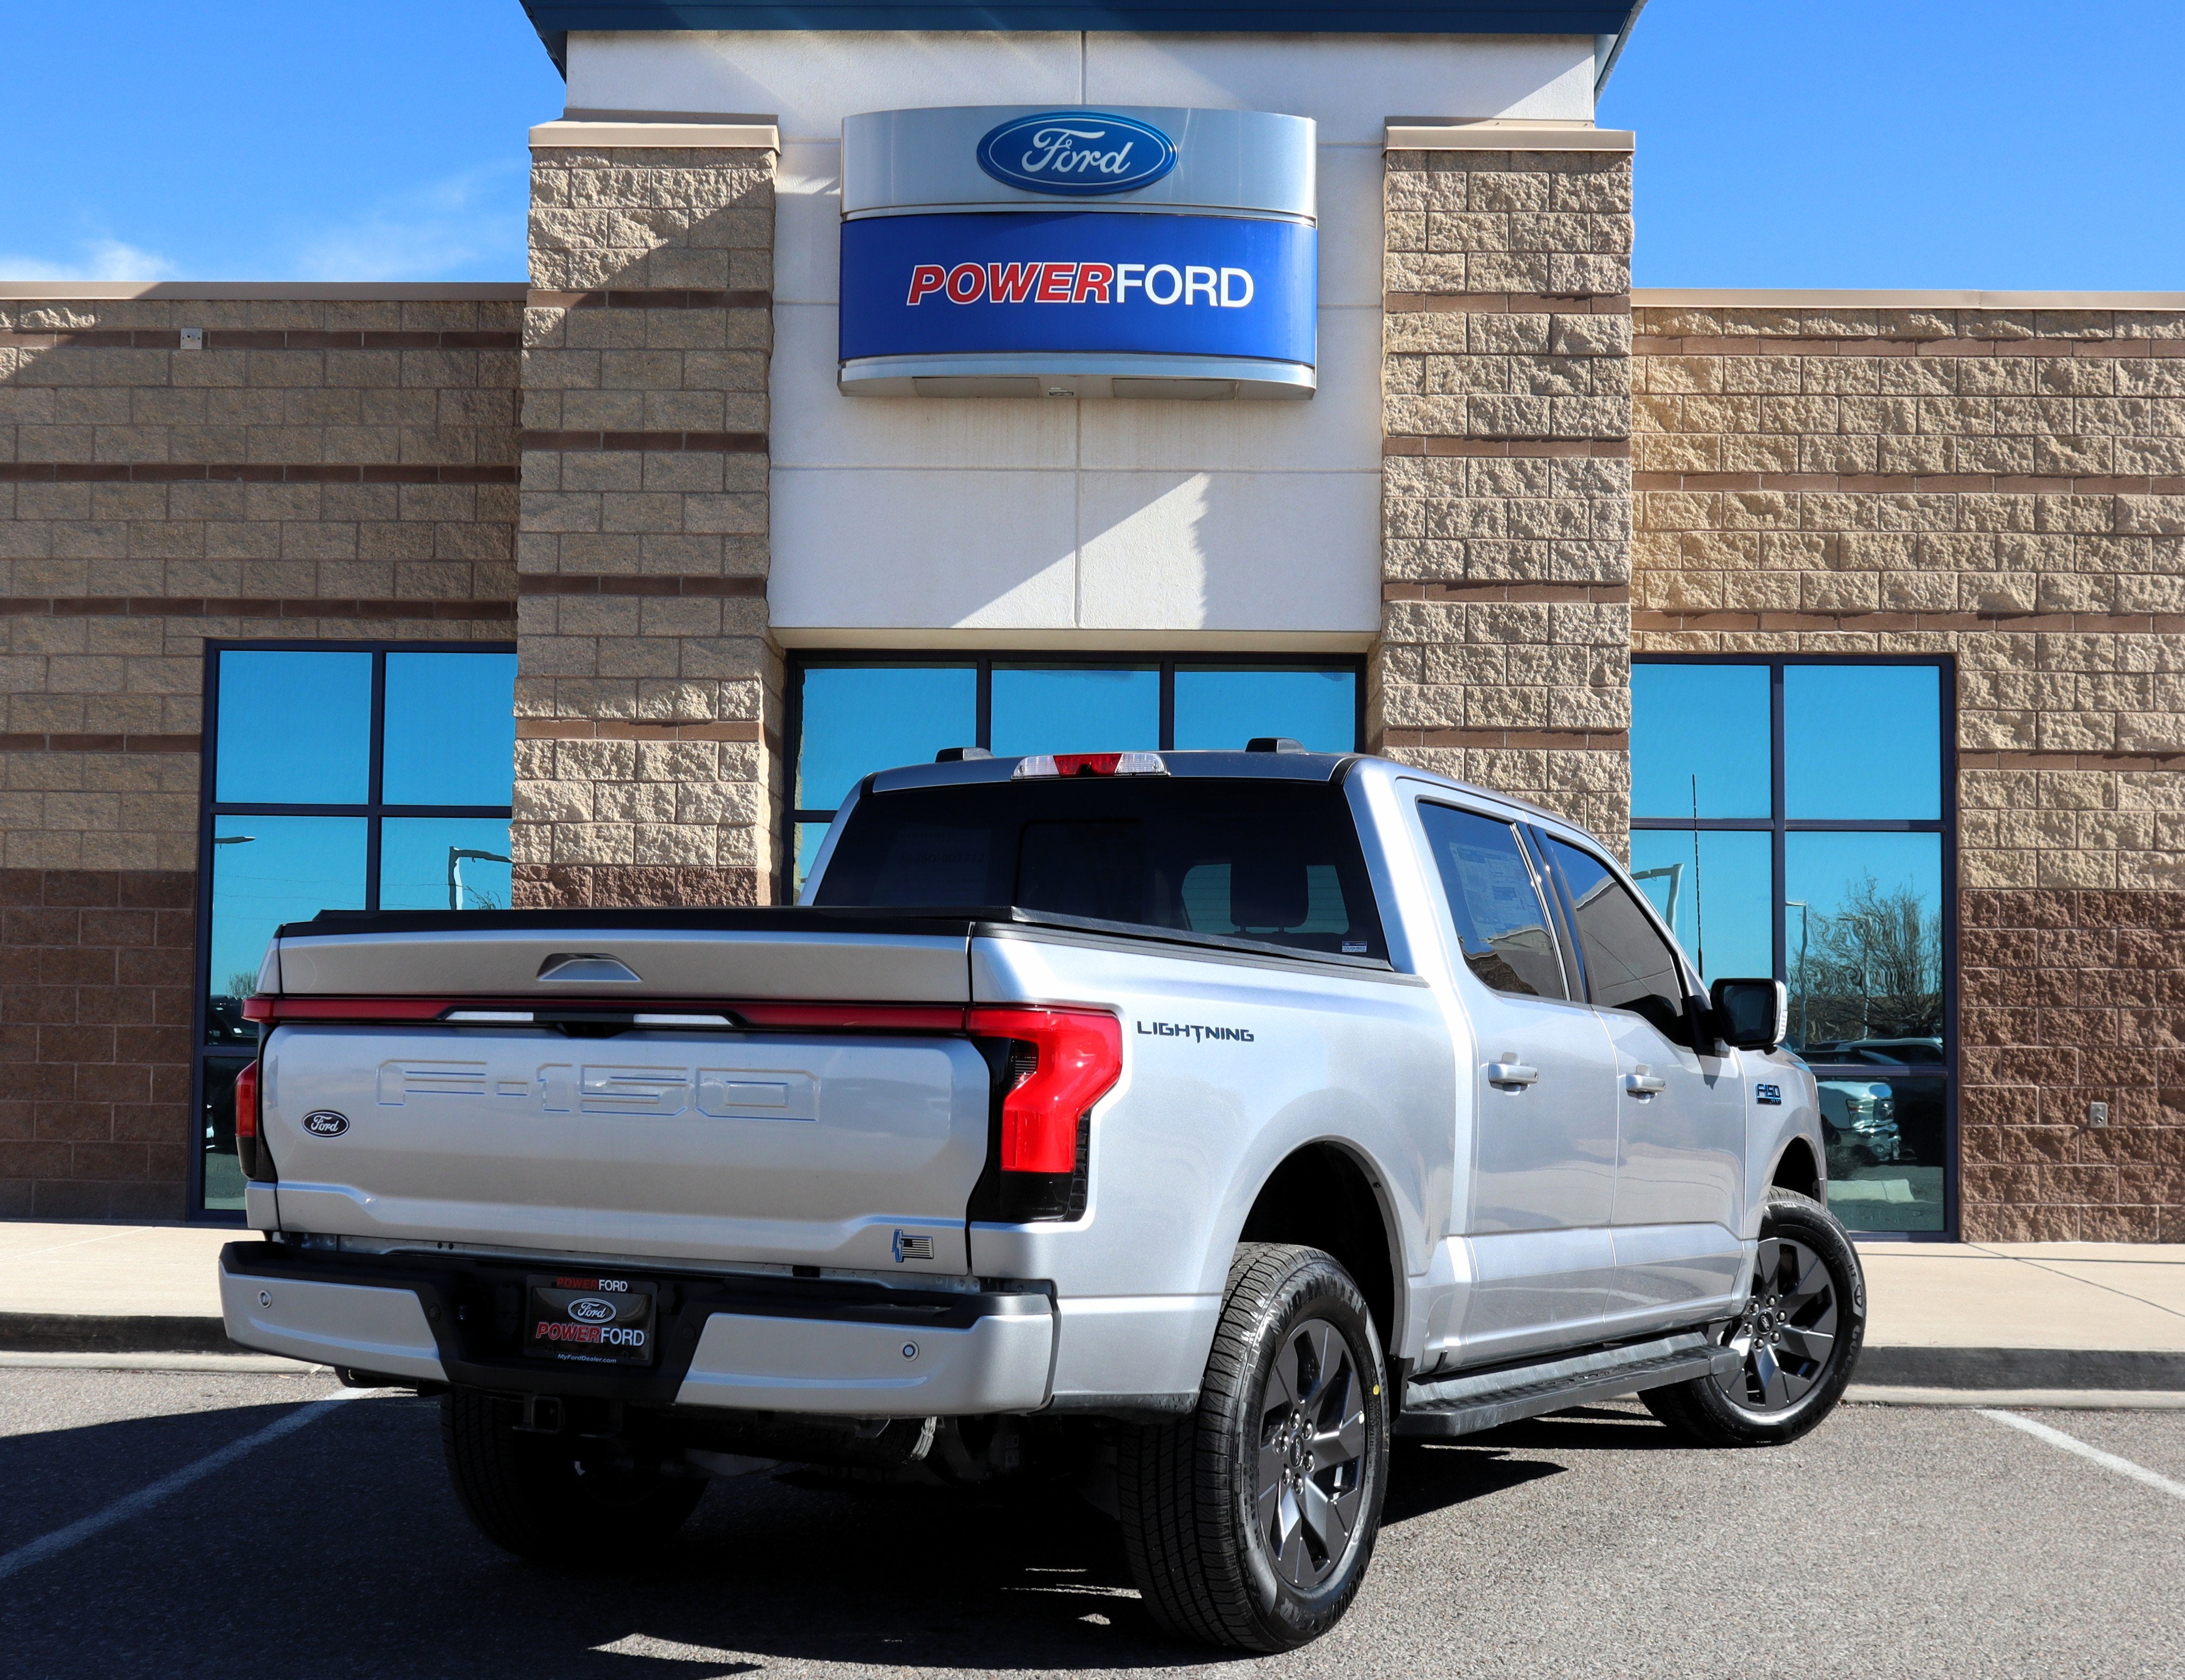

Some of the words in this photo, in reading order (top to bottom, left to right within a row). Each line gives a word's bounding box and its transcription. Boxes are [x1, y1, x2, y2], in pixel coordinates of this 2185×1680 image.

[1021, 127, 1132, 175] Ford
[906, 262, 1255, 308] POWERFORD
[1137, 1020, 1255, 1044] LIGHTNING
[376, 1058, 821, 1122] F-150
[311, 1115, 340, 1132] Ford
[556, 1277, 628, 1292] POWERFORD
[578, 1302, 606, 1318] Ford
[535, 1322, 645, 1346] POWERFORD
[557, 1353, 617, 1364] MyFordDealer.com
